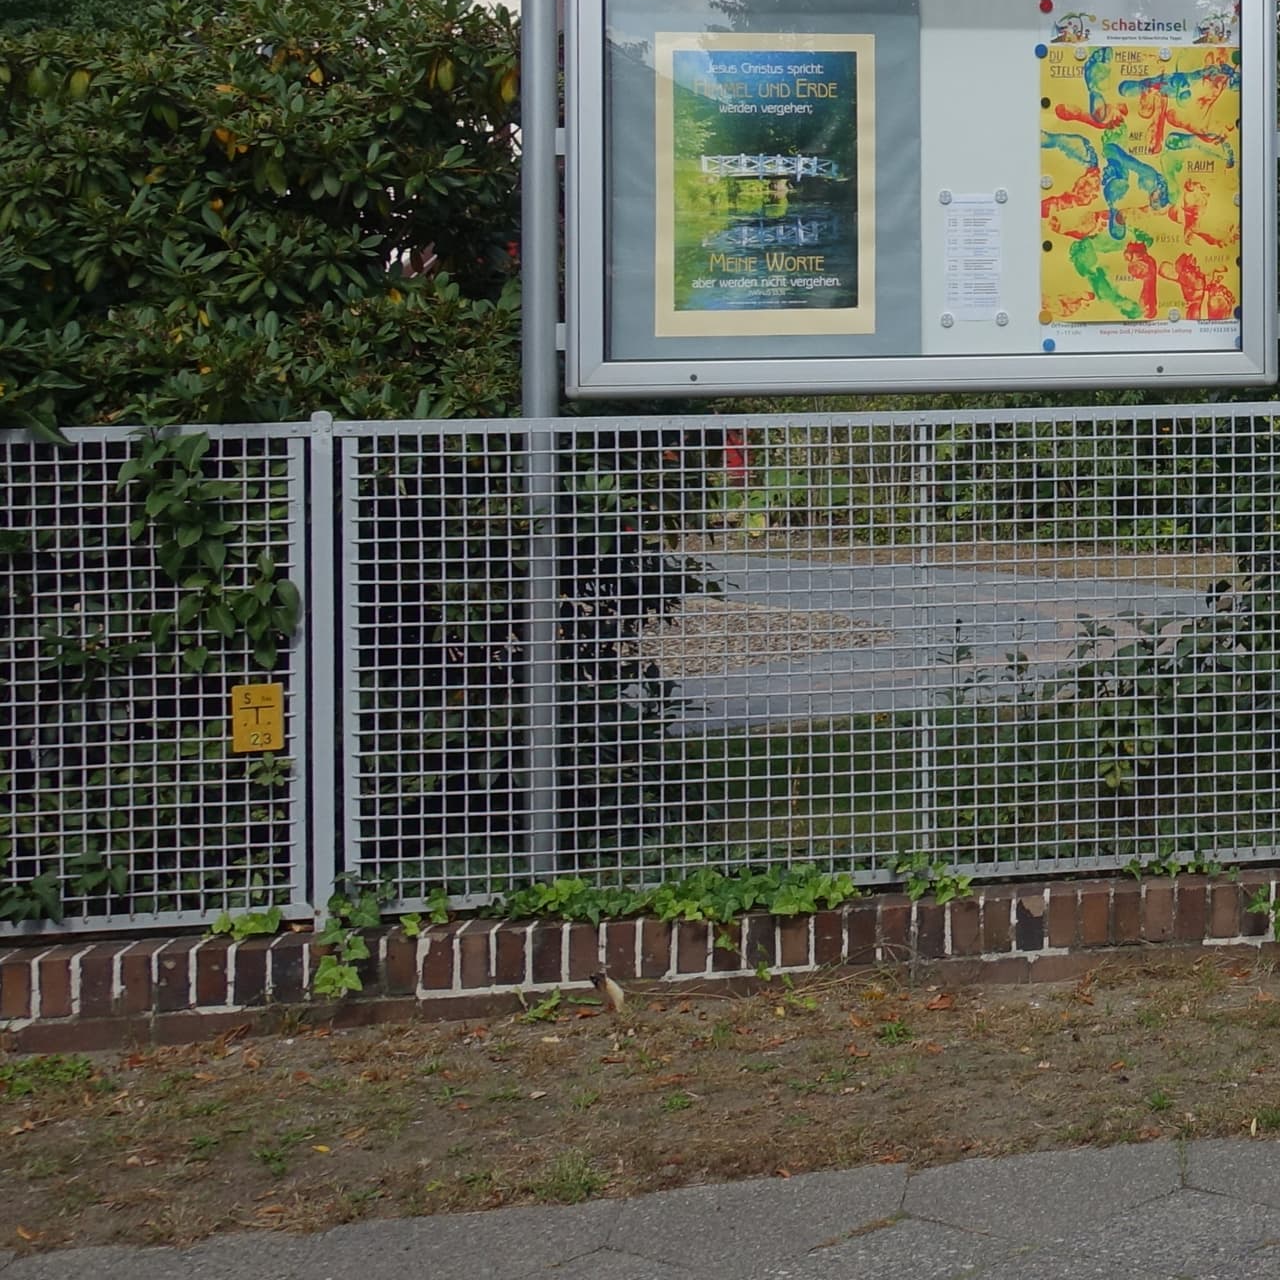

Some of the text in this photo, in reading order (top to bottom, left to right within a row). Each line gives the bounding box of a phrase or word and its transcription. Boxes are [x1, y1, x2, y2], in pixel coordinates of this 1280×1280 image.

[1101, 17, 1187, 33] Schatzinsel
[1049, 50, 1064, 63] DU
[1114, 50, 1142, 62] MEINE
[707, 62, 824, 77] Jesus Christus spricht:
[1120, 62, 1150, 76] FÜSSE
[758, 82, 791, 99] UND
[796, 78, 838, 99] ERDE
[719, 102, 813, 116] werden vergehen;
[1186, 160, 1215, 171] RAUM
[710, 252, 825, 272] MEINE WORTE
[691, 275, 842, 290] aber werden nicht vergehen.
[244, 692, 252, 705] S
[251, 732, 272, 748] 2,3
